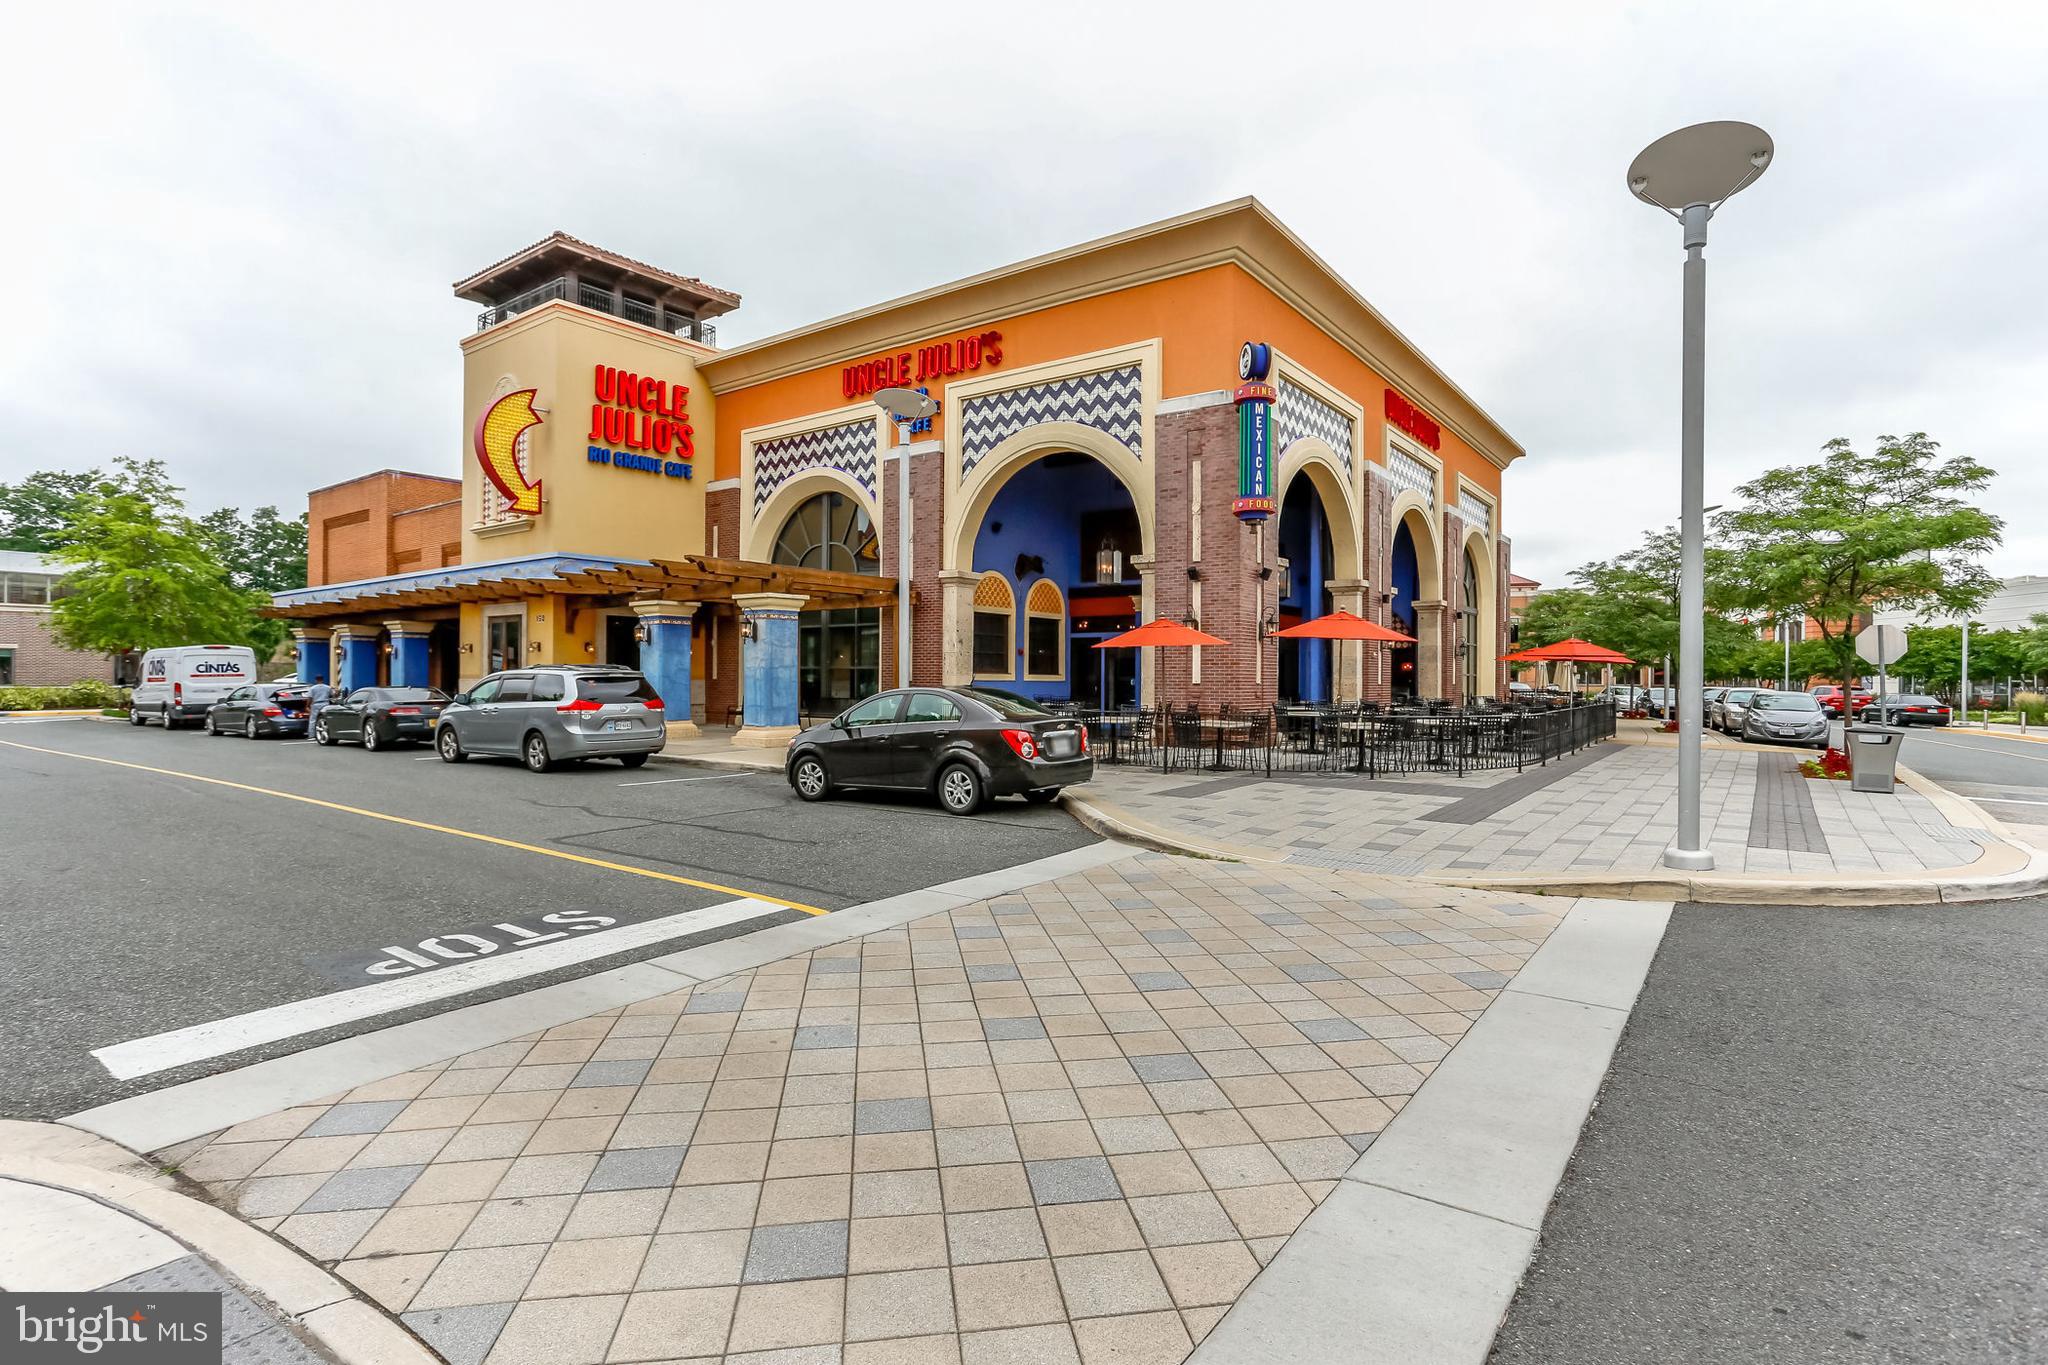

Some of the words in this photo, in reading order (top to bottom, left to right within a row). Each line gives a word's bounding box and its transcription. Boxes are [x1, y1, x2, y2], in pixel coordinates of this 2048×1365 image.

[595, 364, 690, 420] UNCLE
[843, 352, 912, 398] UNCLE
[916, 331, 1003, 382] JULIO'S
[1250, 386, 1273, 396] FINE
[588, 404, 695, 459] JULIO'S
[1255, 402, 1264, 495] MEXICAN
[588, 446, 611, 463] RIO
[614, 451, 663, 474] GRANDE
[665, 461, 693, 480] CAFE
[1248, 500, 1274, 508] FOOD
[195, 661, 240, 674] CINTAS
[365, 910, 616, 975] STOP
